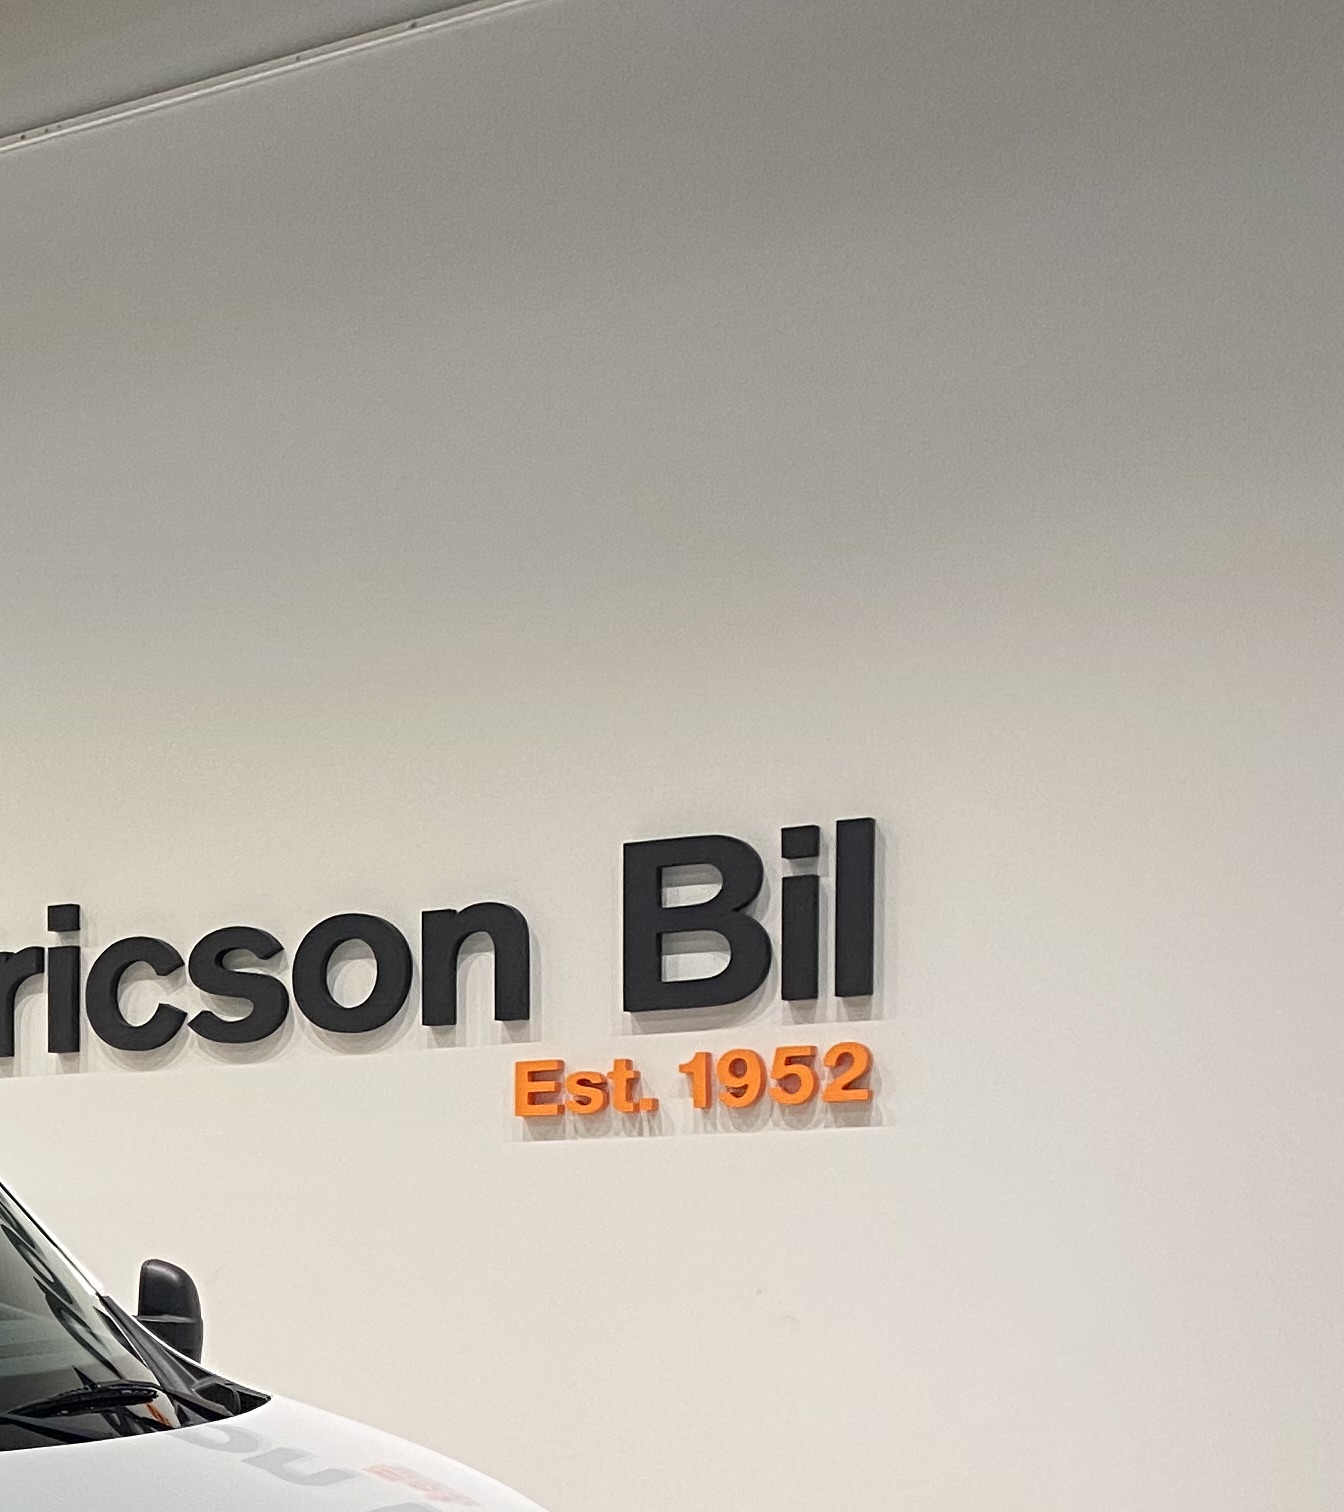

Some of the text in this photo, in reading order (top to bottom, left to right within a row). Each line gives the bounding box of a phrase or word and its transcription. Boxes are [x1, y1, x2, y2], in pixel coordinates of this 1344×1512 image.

[622, 817, 876, 1014] Bil
[513, 1041, 873, 1119] Est. 1952
